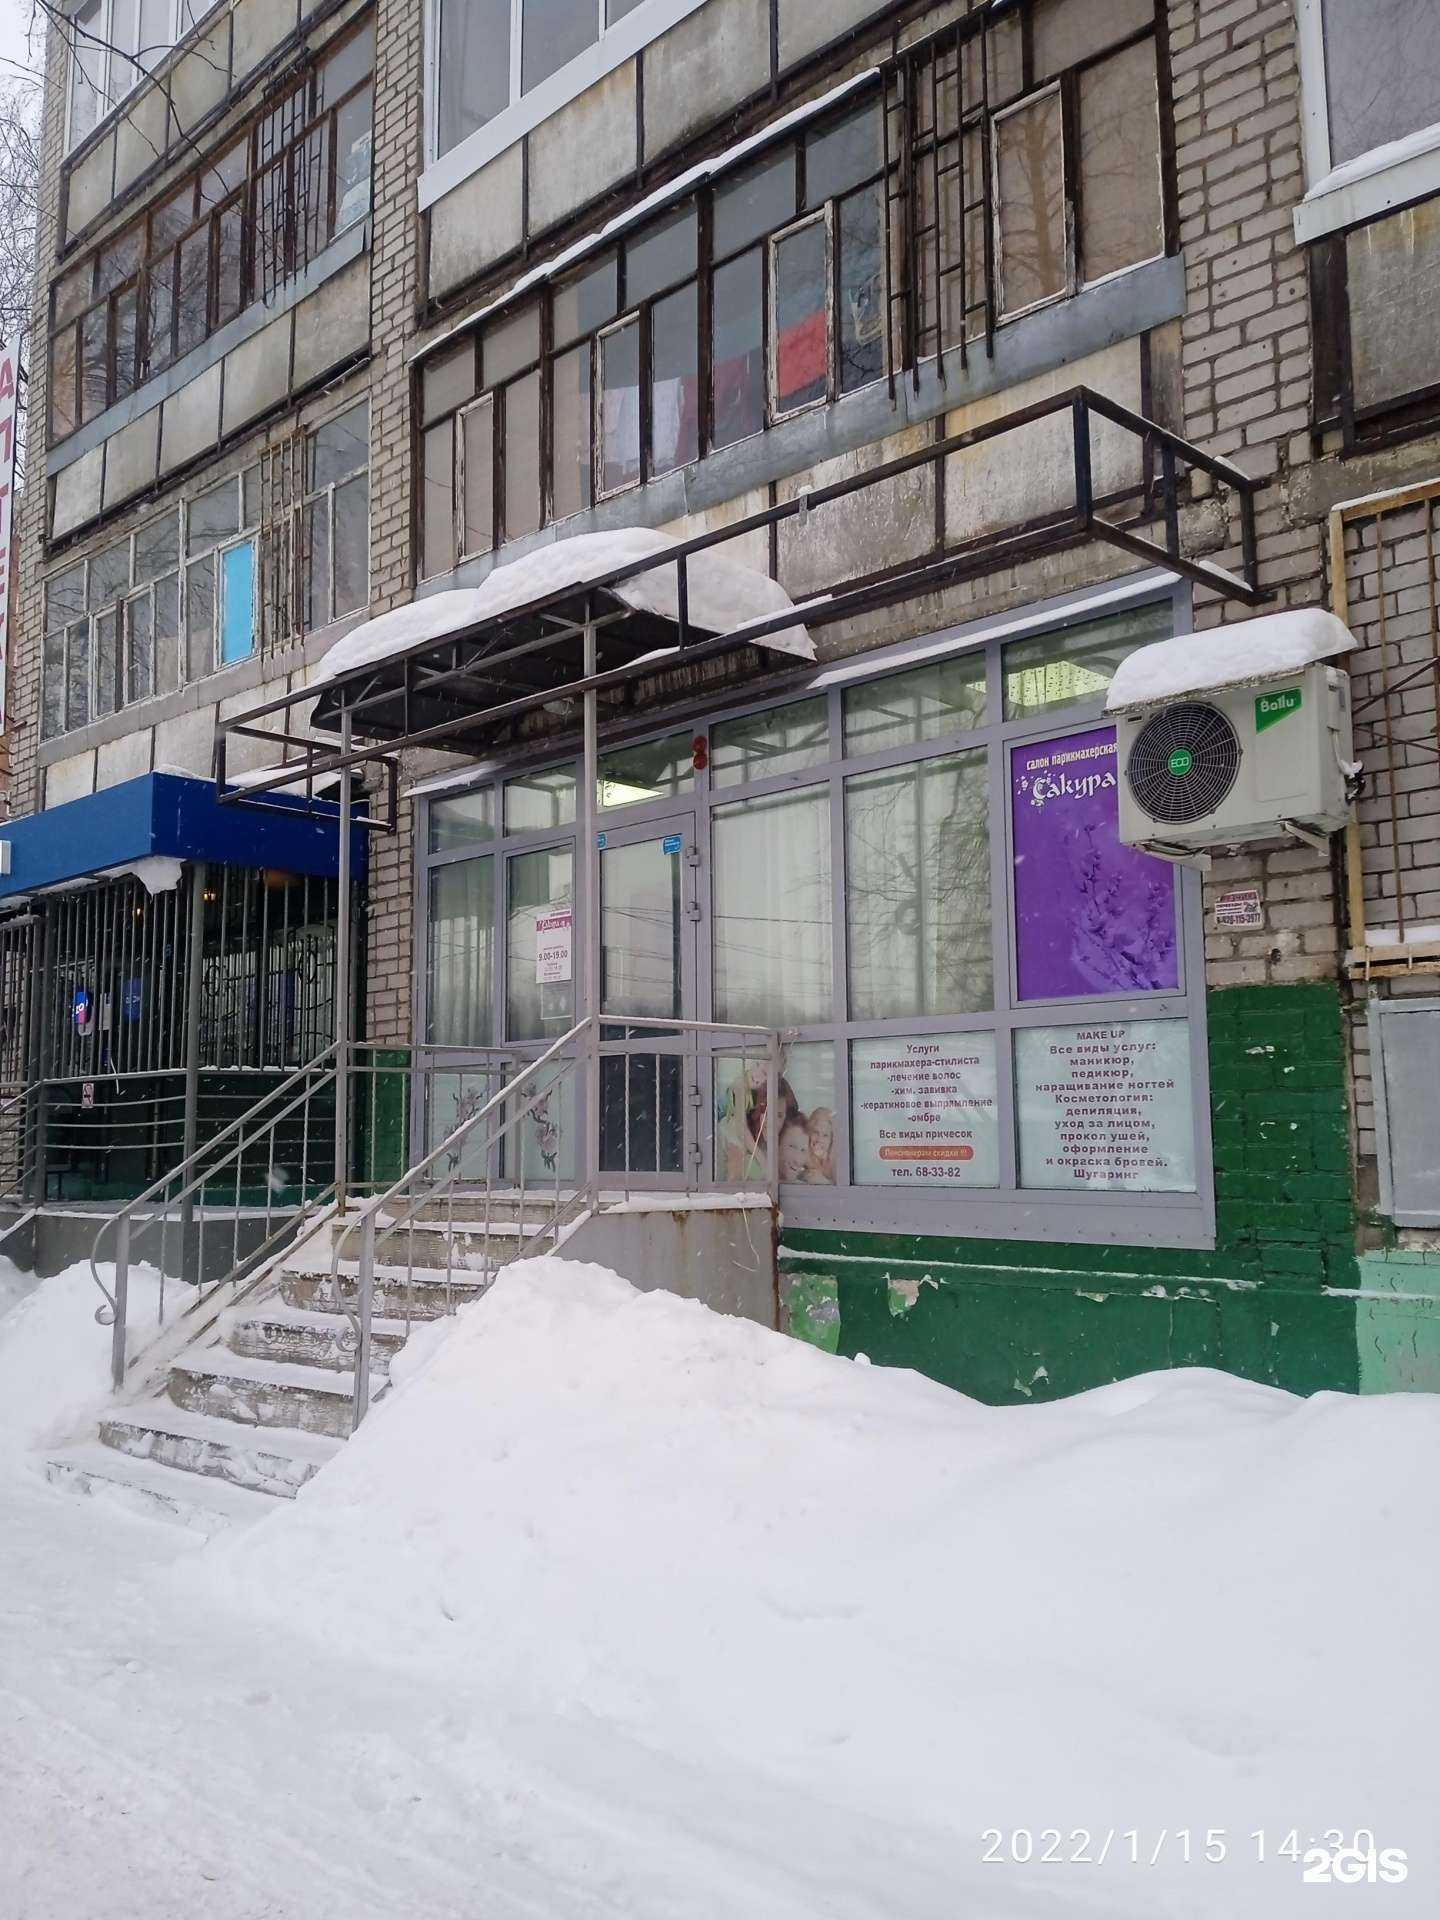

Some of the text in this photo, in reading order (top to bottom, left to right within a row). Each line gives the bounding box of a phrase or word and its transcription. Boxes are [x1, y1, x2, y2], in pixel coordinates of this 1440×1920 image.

[1260, 694, 1295, 713] Ballu
[1026, 742, 1119, 771] салон парикмахерская
[1031, 771, 1118, 801] Сакура
[1076, 1030, 1126, 1040] MAKE UP
[906, 1044, 940, 1056] Услуги
[1050, 1042, 1156, 1055] Все виды услуг:
[870, 1056, 980, 1071] парикмахера-стилиста
[1070, 1056, 1135, 1066] маникюр,
[888, 1072, 961, 1082] -лечение волос
[1071, 1069, 1134, 1079] педикюр,
[891, 1085, 958, 1096] -хим. завивка
[1035, 1079, 1175, 1093] наращивание ногтей
[860, 1098, 993, 1112] -кератиновое выпрямление
[1055, 1094, 1153, 1104] Косметология:
[907, 1112, 941, 1124] -омбре
[1065, 1107, 1142, 1117] депиляция,
[1054, 1120, 1156, 1130] уход за лицом,
[879, 1129, 973, 1141] Все виды причесок
[1060, 1131, 1150, 1143] прокол ушей,
[1062, 1144, 1149, 1155] оформление
[1046, 1157, 1168, 1168] и окраска бровей.
[892, 1166, 961, 1178] тел. 68-33-82
[1073, 1168, 1139, 1180] Шугаринг
